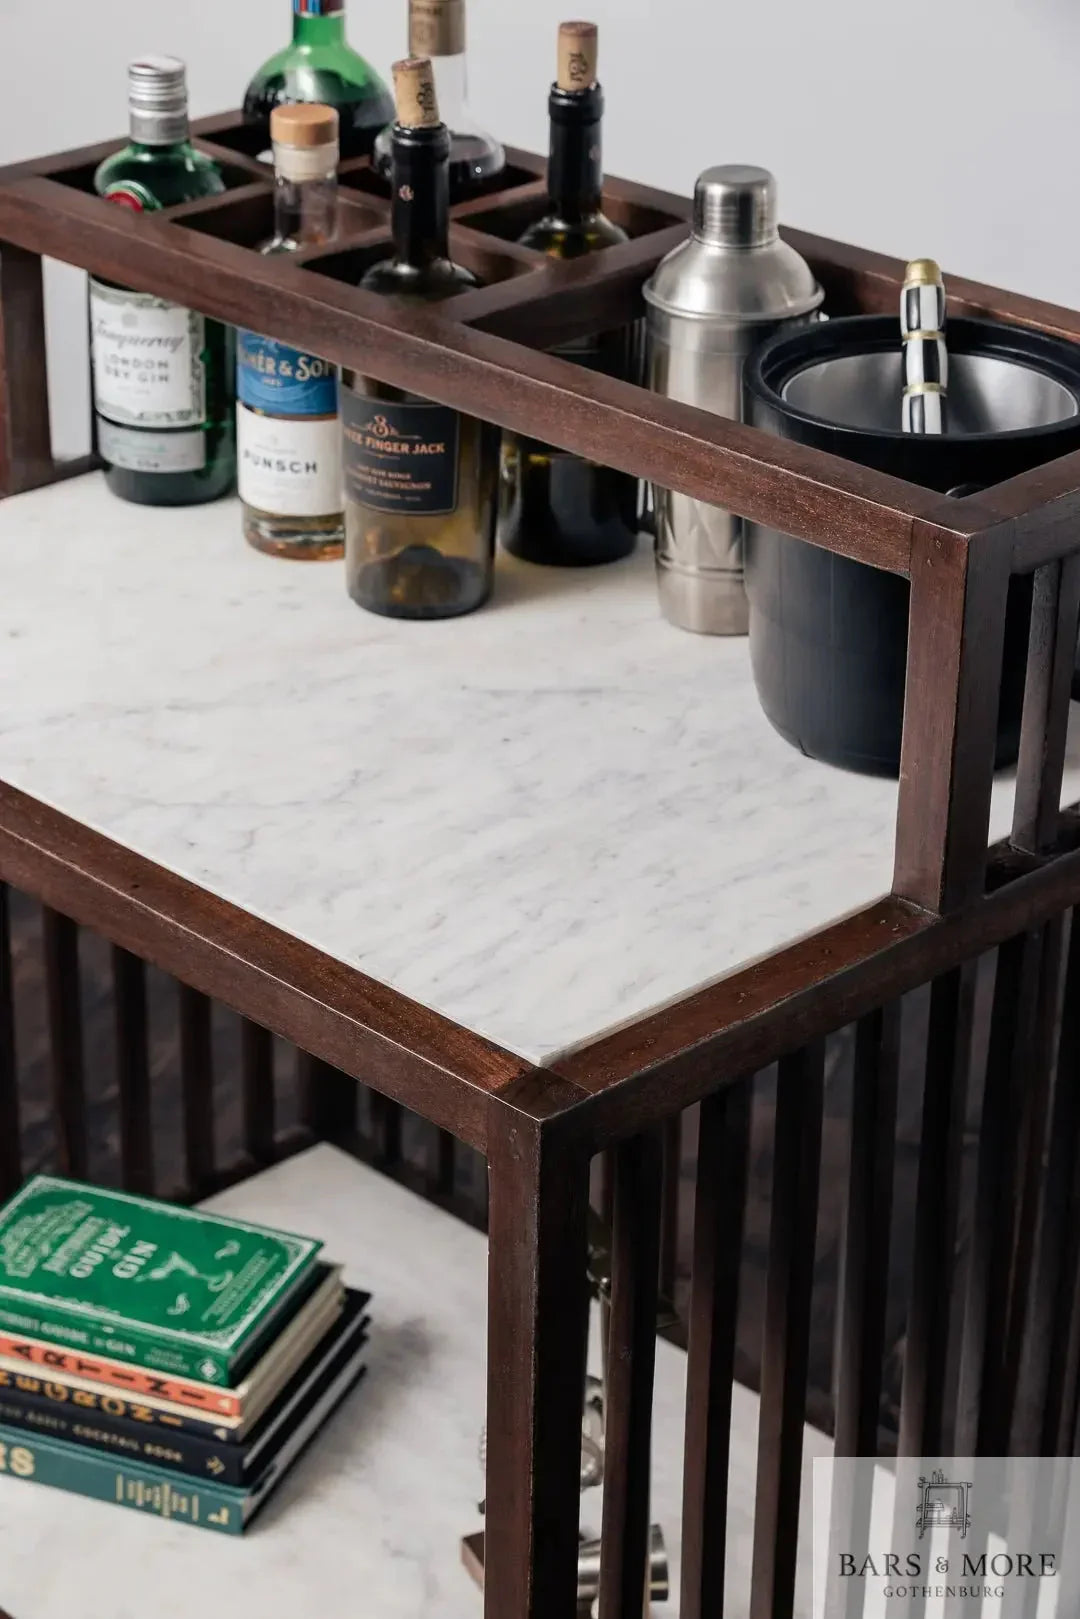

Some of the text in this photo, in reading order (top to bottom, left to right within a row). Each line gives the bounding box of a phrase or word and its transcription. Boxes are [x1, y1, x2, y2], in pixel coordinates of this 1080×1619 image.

[104, 352, 168, 369] LONDON
[137, 371, 168, 384] GIN
[365, 436, 409, 454] FINGER
[412, 442, 445, 455] JACK
[243, 448, 318, 475] PUNSCH
[112, 1239, 158, 1279] GIN
[144, 1442, 183, 1461] BOOK
